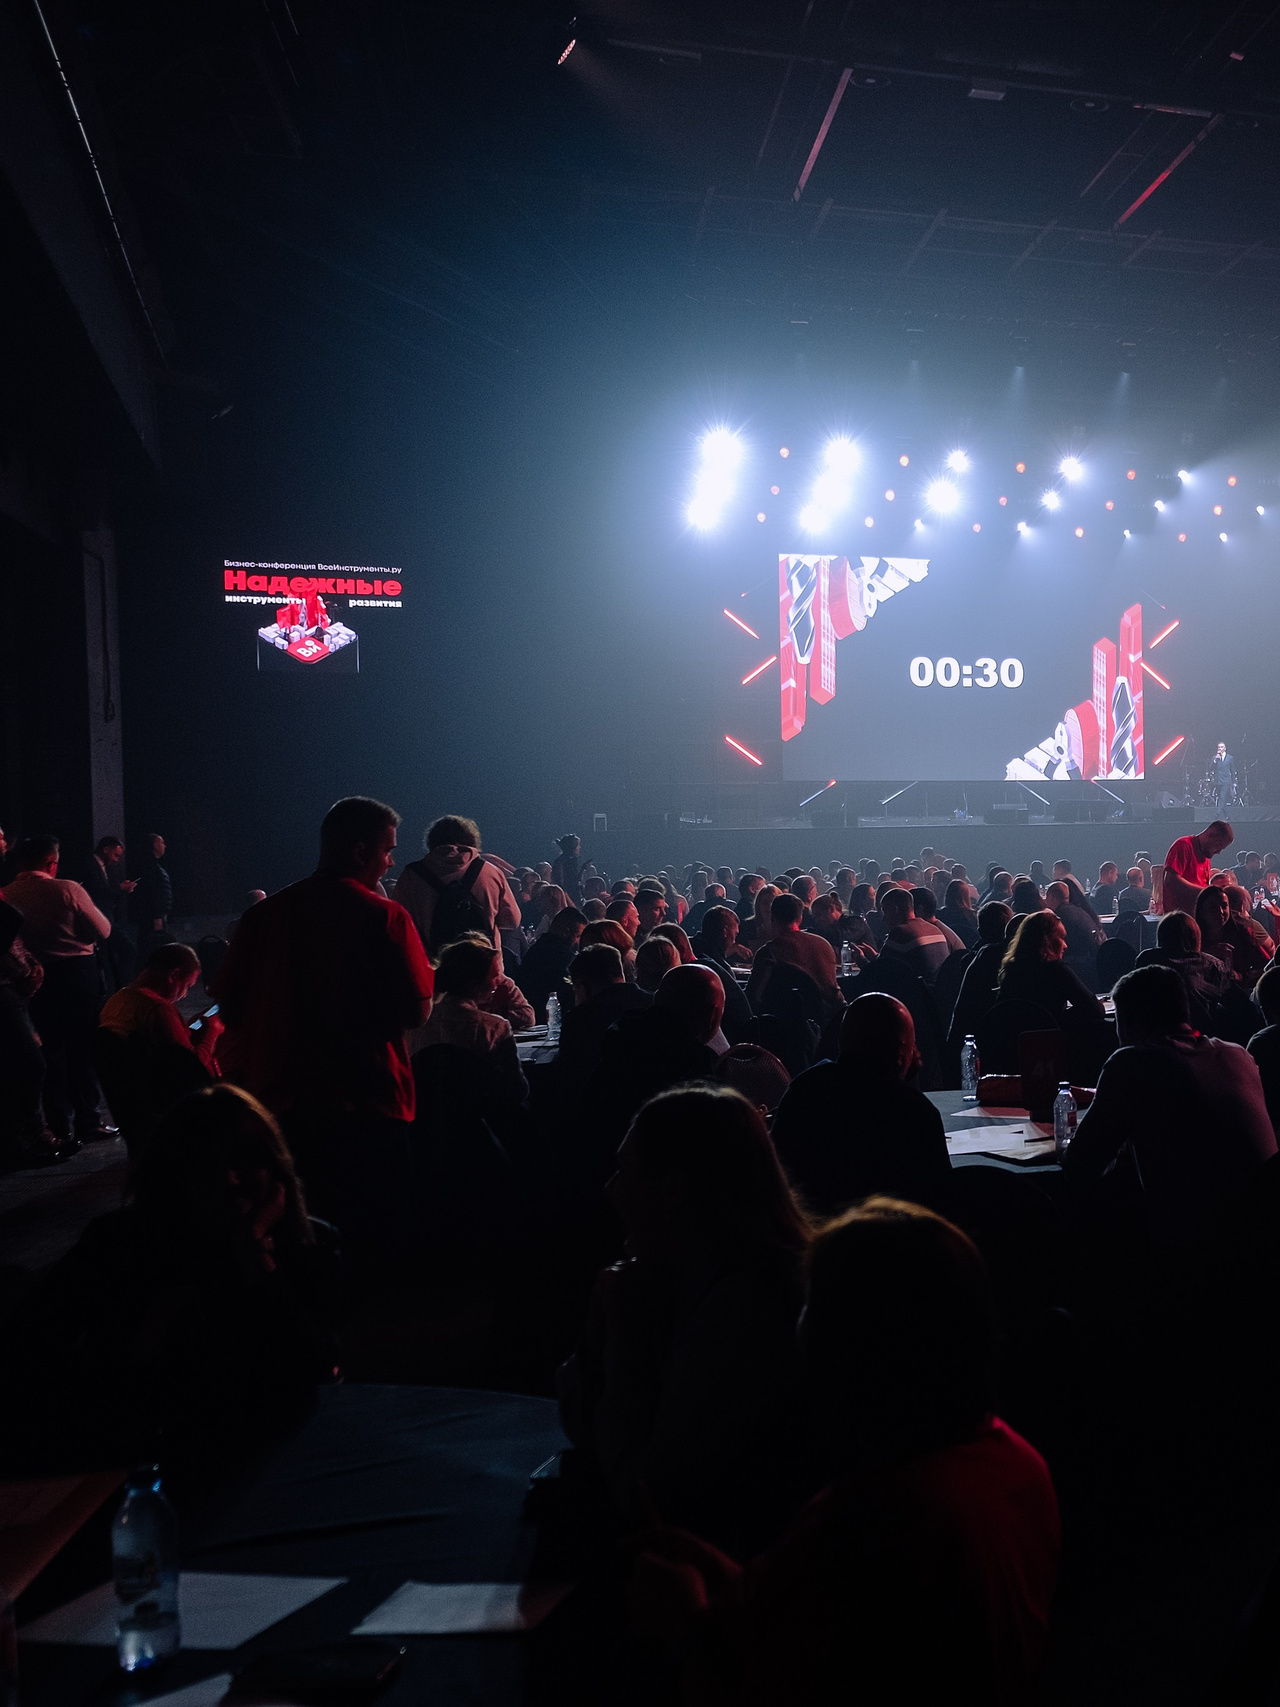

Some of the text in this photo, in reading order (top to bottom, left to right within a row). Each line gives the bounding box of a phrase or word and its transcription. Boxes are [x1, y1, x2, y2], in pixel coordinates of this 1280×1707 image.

[224, 560, 402, 574] Бизнес-конференция ВсеИнструменты.ру
[224, 569, 403, 596] Надежные
[225, 595, 402, 608] инструменты развития
[910, 656, 1025, 688] 00:30
